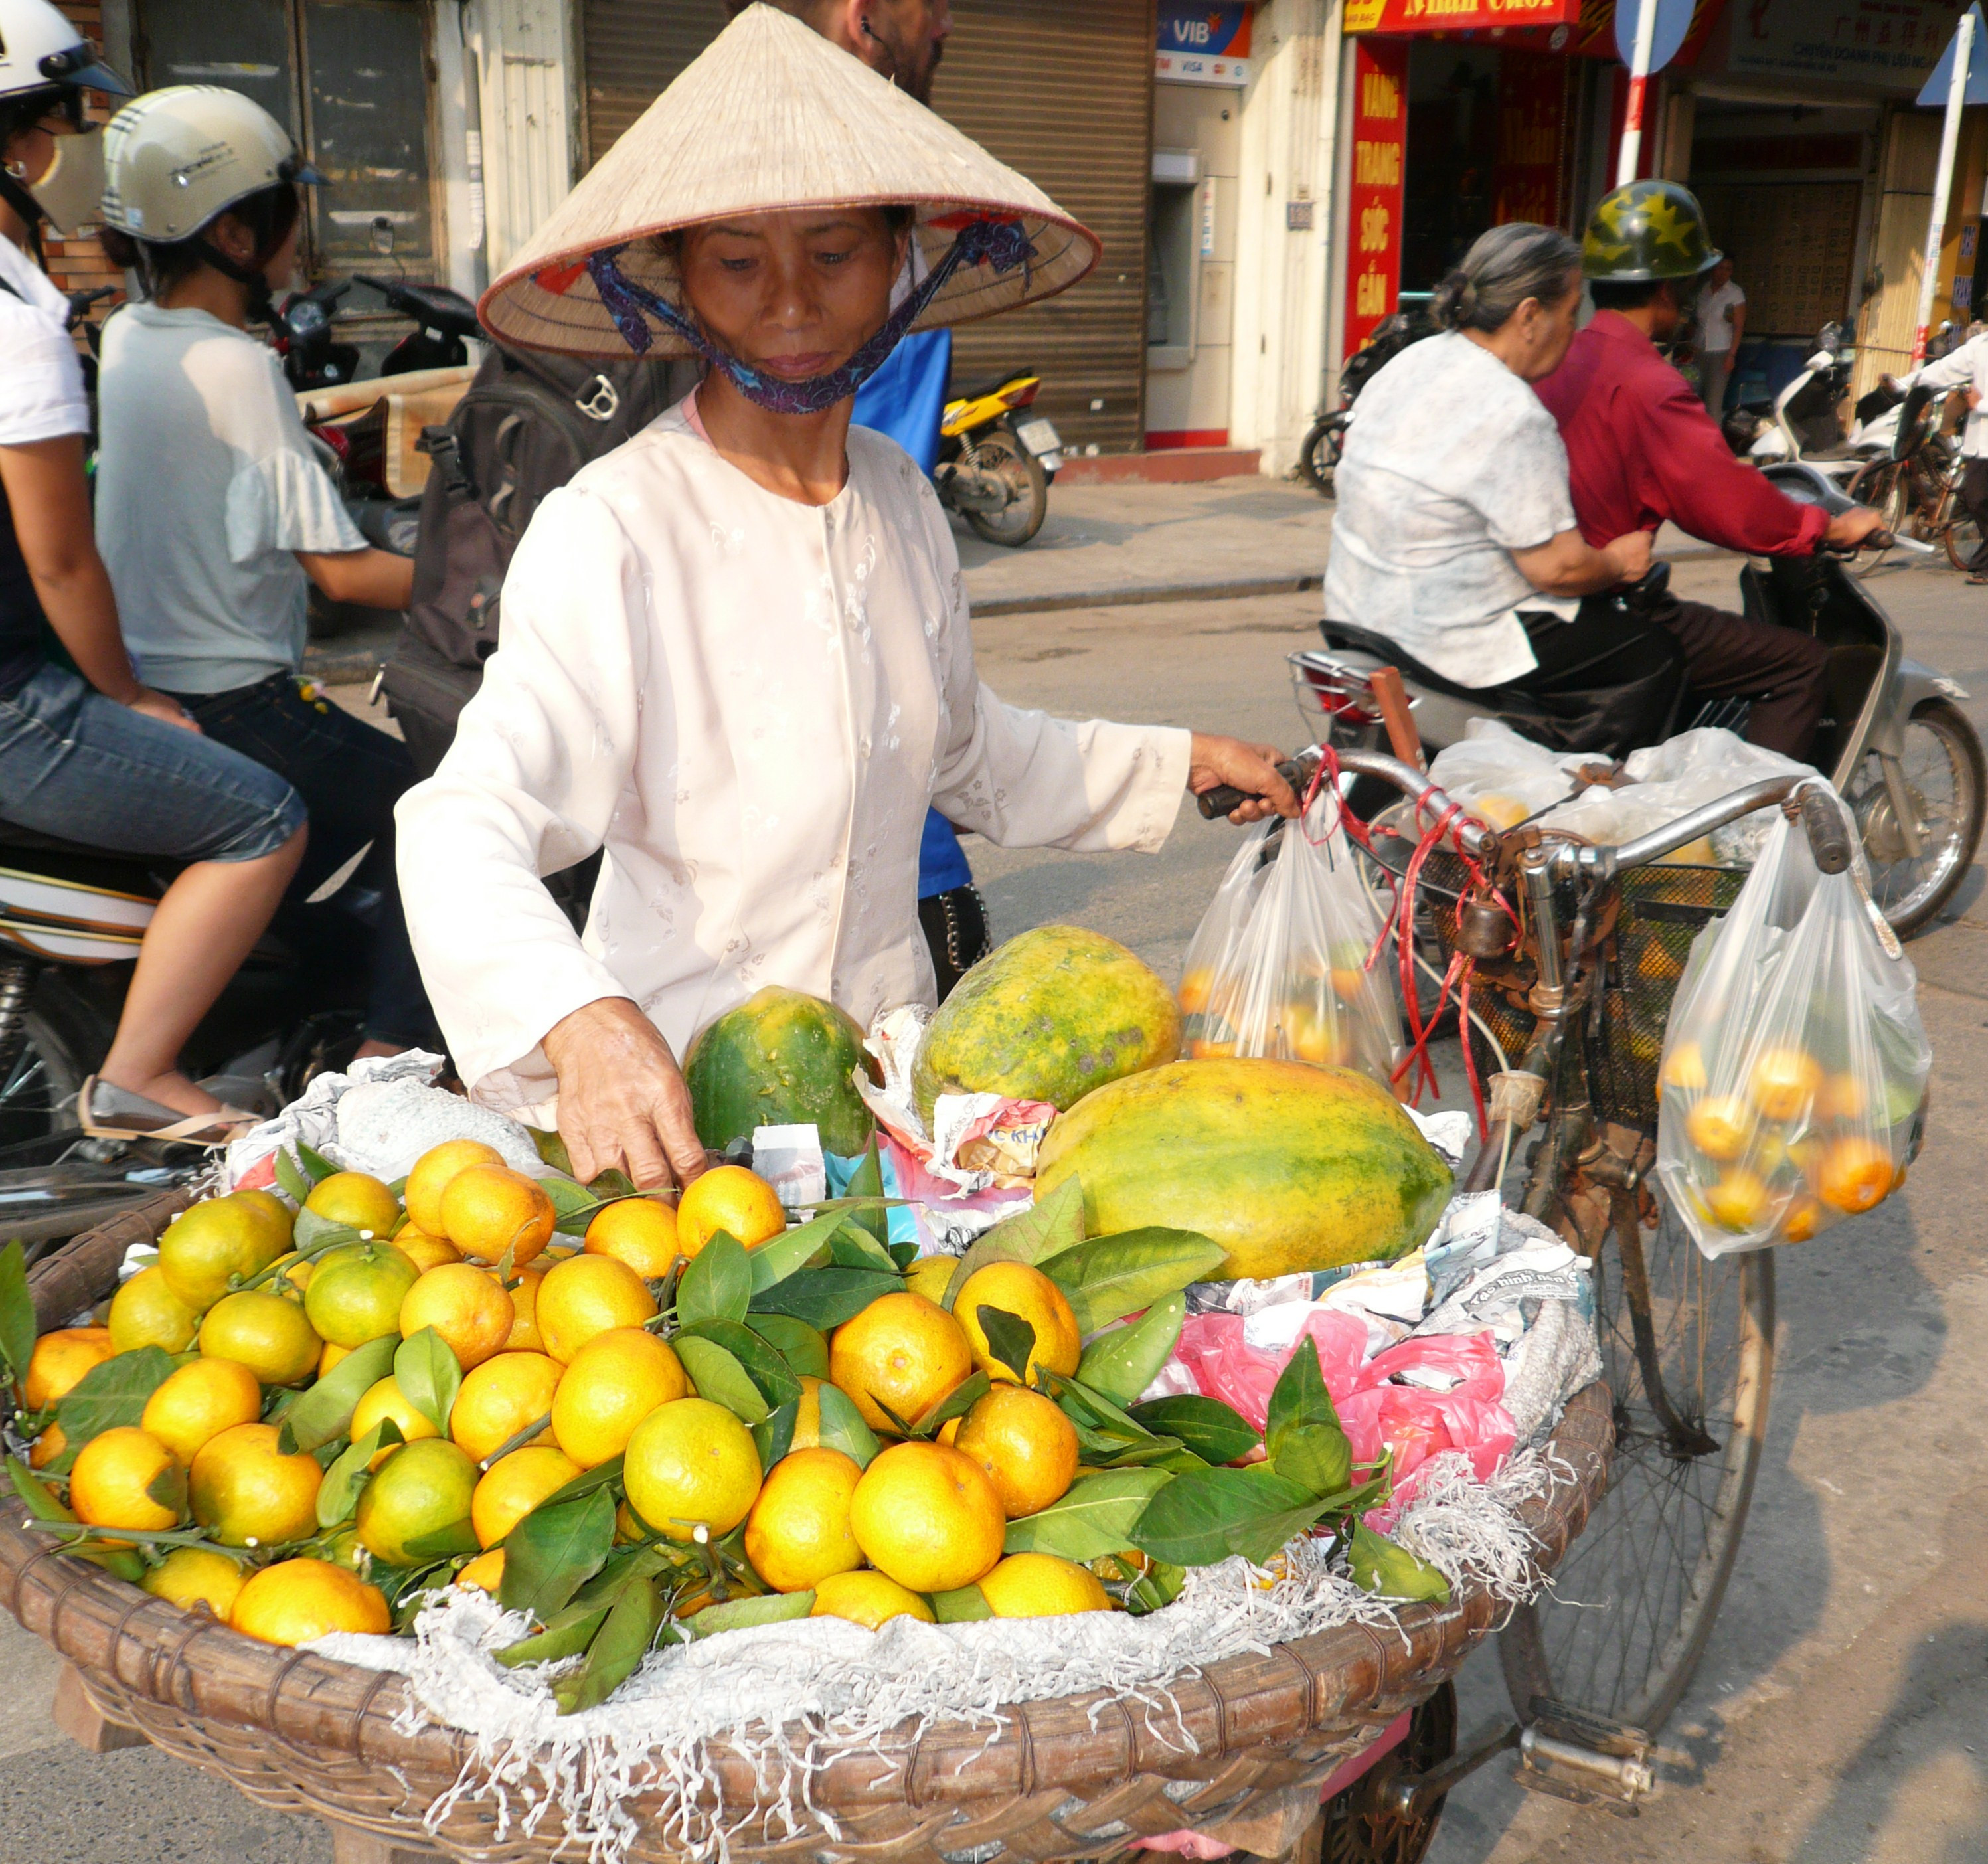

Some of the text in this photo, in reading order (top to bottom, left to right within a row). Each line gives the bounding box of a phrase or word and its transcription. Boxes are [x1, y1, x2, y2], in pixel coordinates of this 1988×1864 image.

[1173, 19, 1210, 44] VIB
[1155, 57, 1202, 72] TM VISA
[1362, 64, 1398, 118] VÀNG
[1356, 140, 1400, 185] TRANG
[1359, 195, 1390, 252] SỨC
